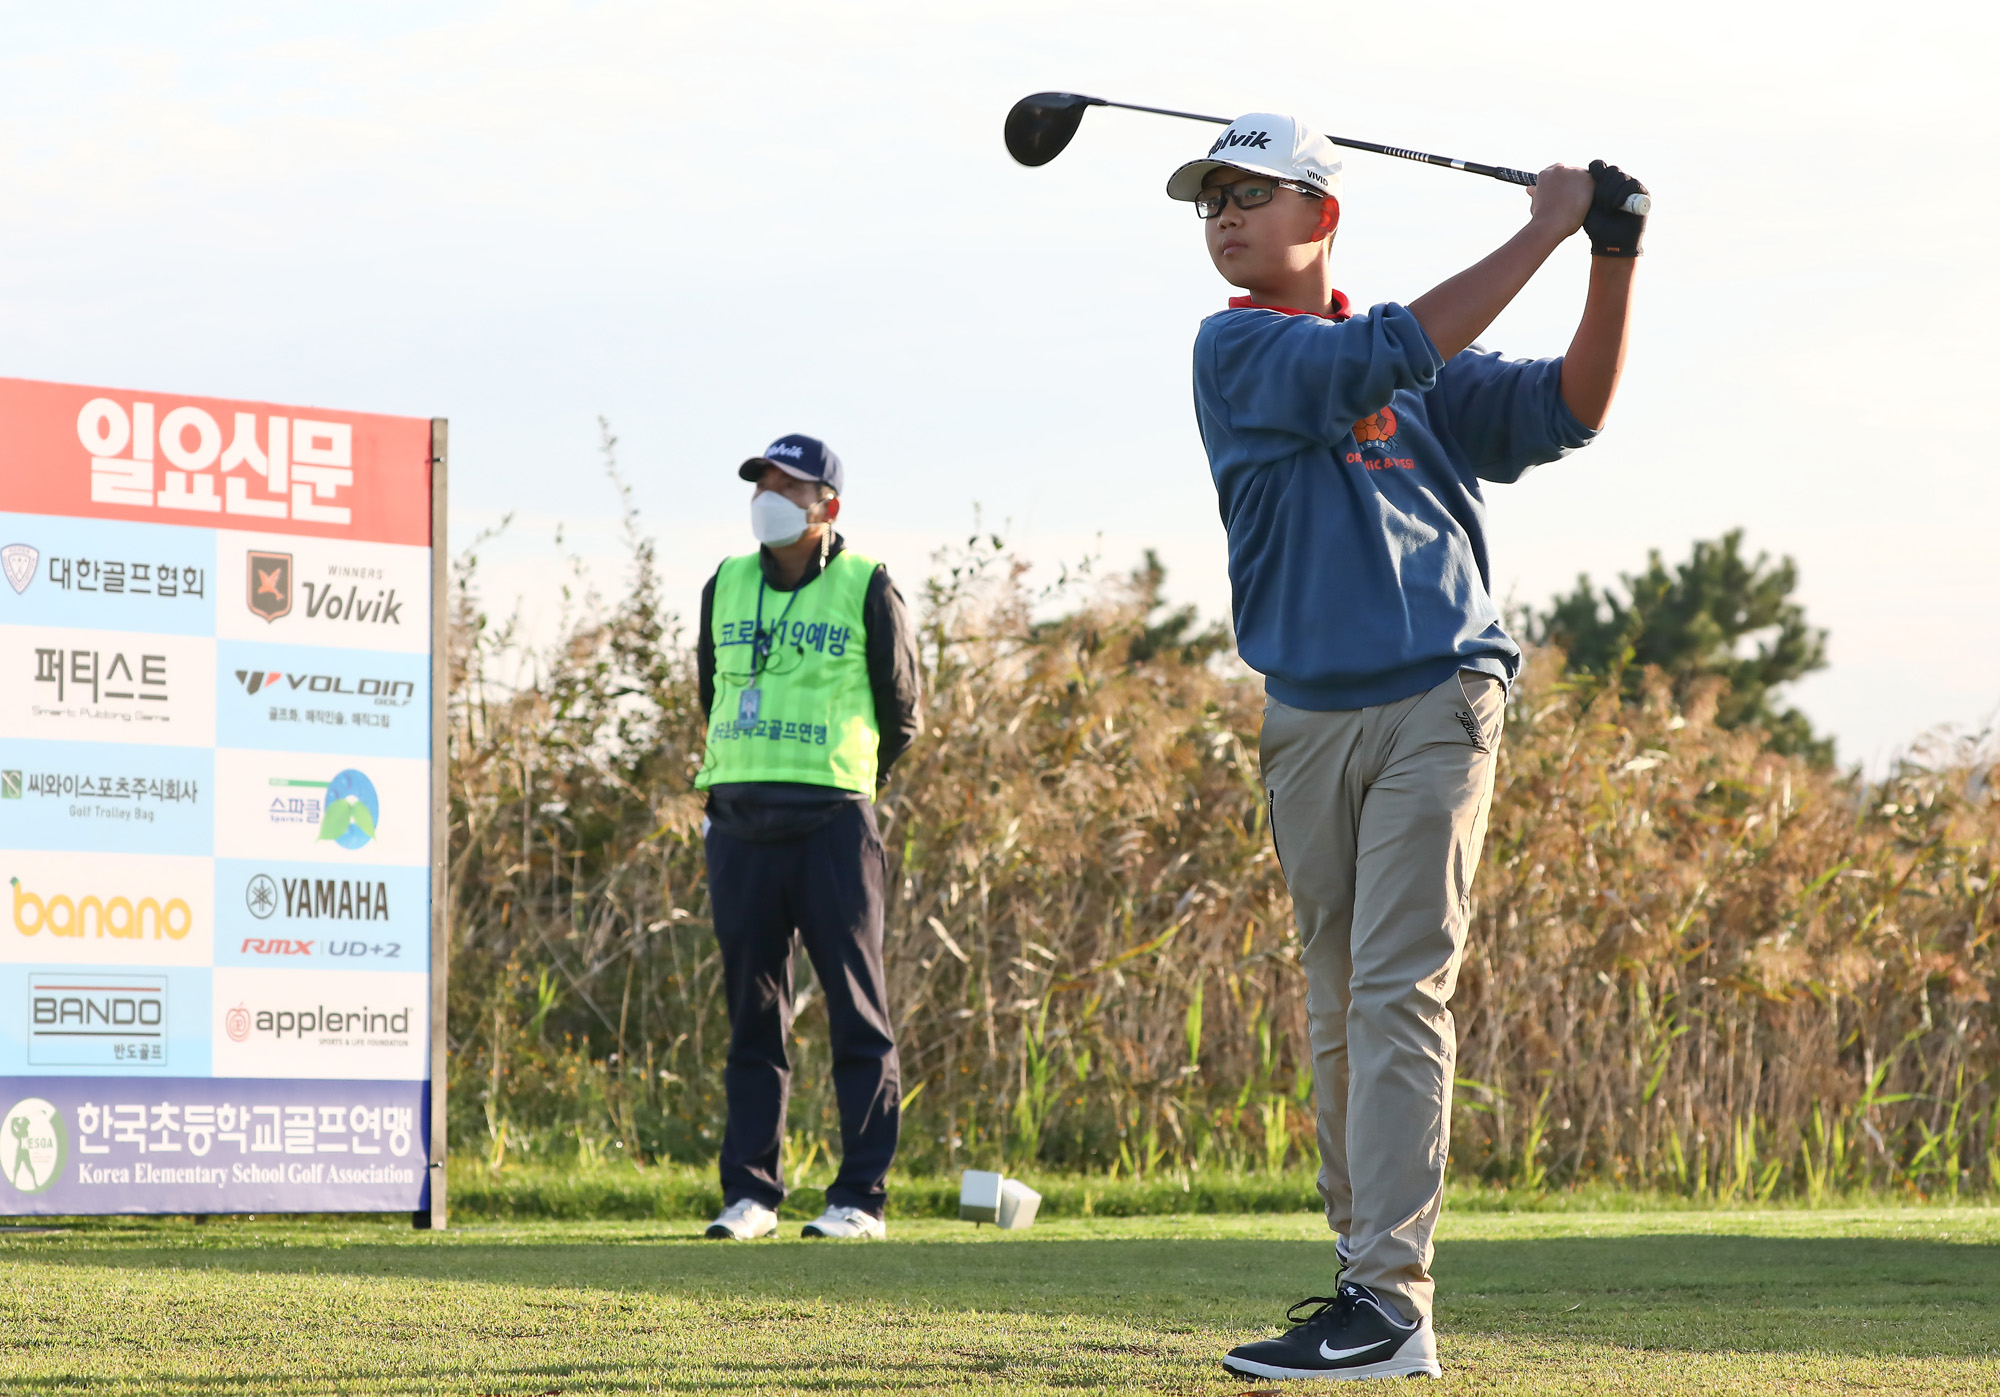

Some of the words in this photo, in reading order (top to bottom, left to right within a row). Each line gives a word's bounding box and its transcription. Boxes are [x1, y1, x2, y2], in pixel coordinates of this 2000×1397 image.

[1206, 129, 1272, 158] olvik
[1306, 169, 1329, 187] VIVID
[77, 397, 353, 525] 일요신문
[765, 442, 804, 460] olvik
[1384, 457, 1394, 469] &
[49, 557, 204, 600] 대한골프협회
[328, 565, 383, 580] WINNERS
[302, 582, 403, 625] Volvik
[34, 648, 168, 704] 퍼티스트
[32, 705, 75, 717] Smart
[135, 710, 170, 722] Game
[28, 774, 198, 804] 씨와이스포츠주식회사
[69, 804, 92, 818] Golf
[95, 805, 131, 821] Trolley
[134, 807, 154, 823] Bag
[269, 797, 321, 824] 스파클
[10, 875, 193, 941] banano
[282, 878, 389, 921] YAMAHA
[241, 938, 315, 956] RMX
[328, 940, 402, 959] UD+2
[33, 996, 162, 1026] BANDO
[256, 1005, 409, 1039] applerind
[114, 1043, 162, 1060] 반도골프
[318, 1037, 343, 1047] SPORTS
[352, 1038, 366, 1047] LIFE
[367, 1038, 409, 1048] FOUNDATION
[77, 1102, 413, 1157] 한국초등학교골프연맹
[78, 1162, 130, 1184] Korea
[134, 1162, 229, 1189] Elementary
[232, 1162, 285, 1184] School
[287, 1162, 324, 1185] Golf
[326, 1163, 414, 1185] Association
